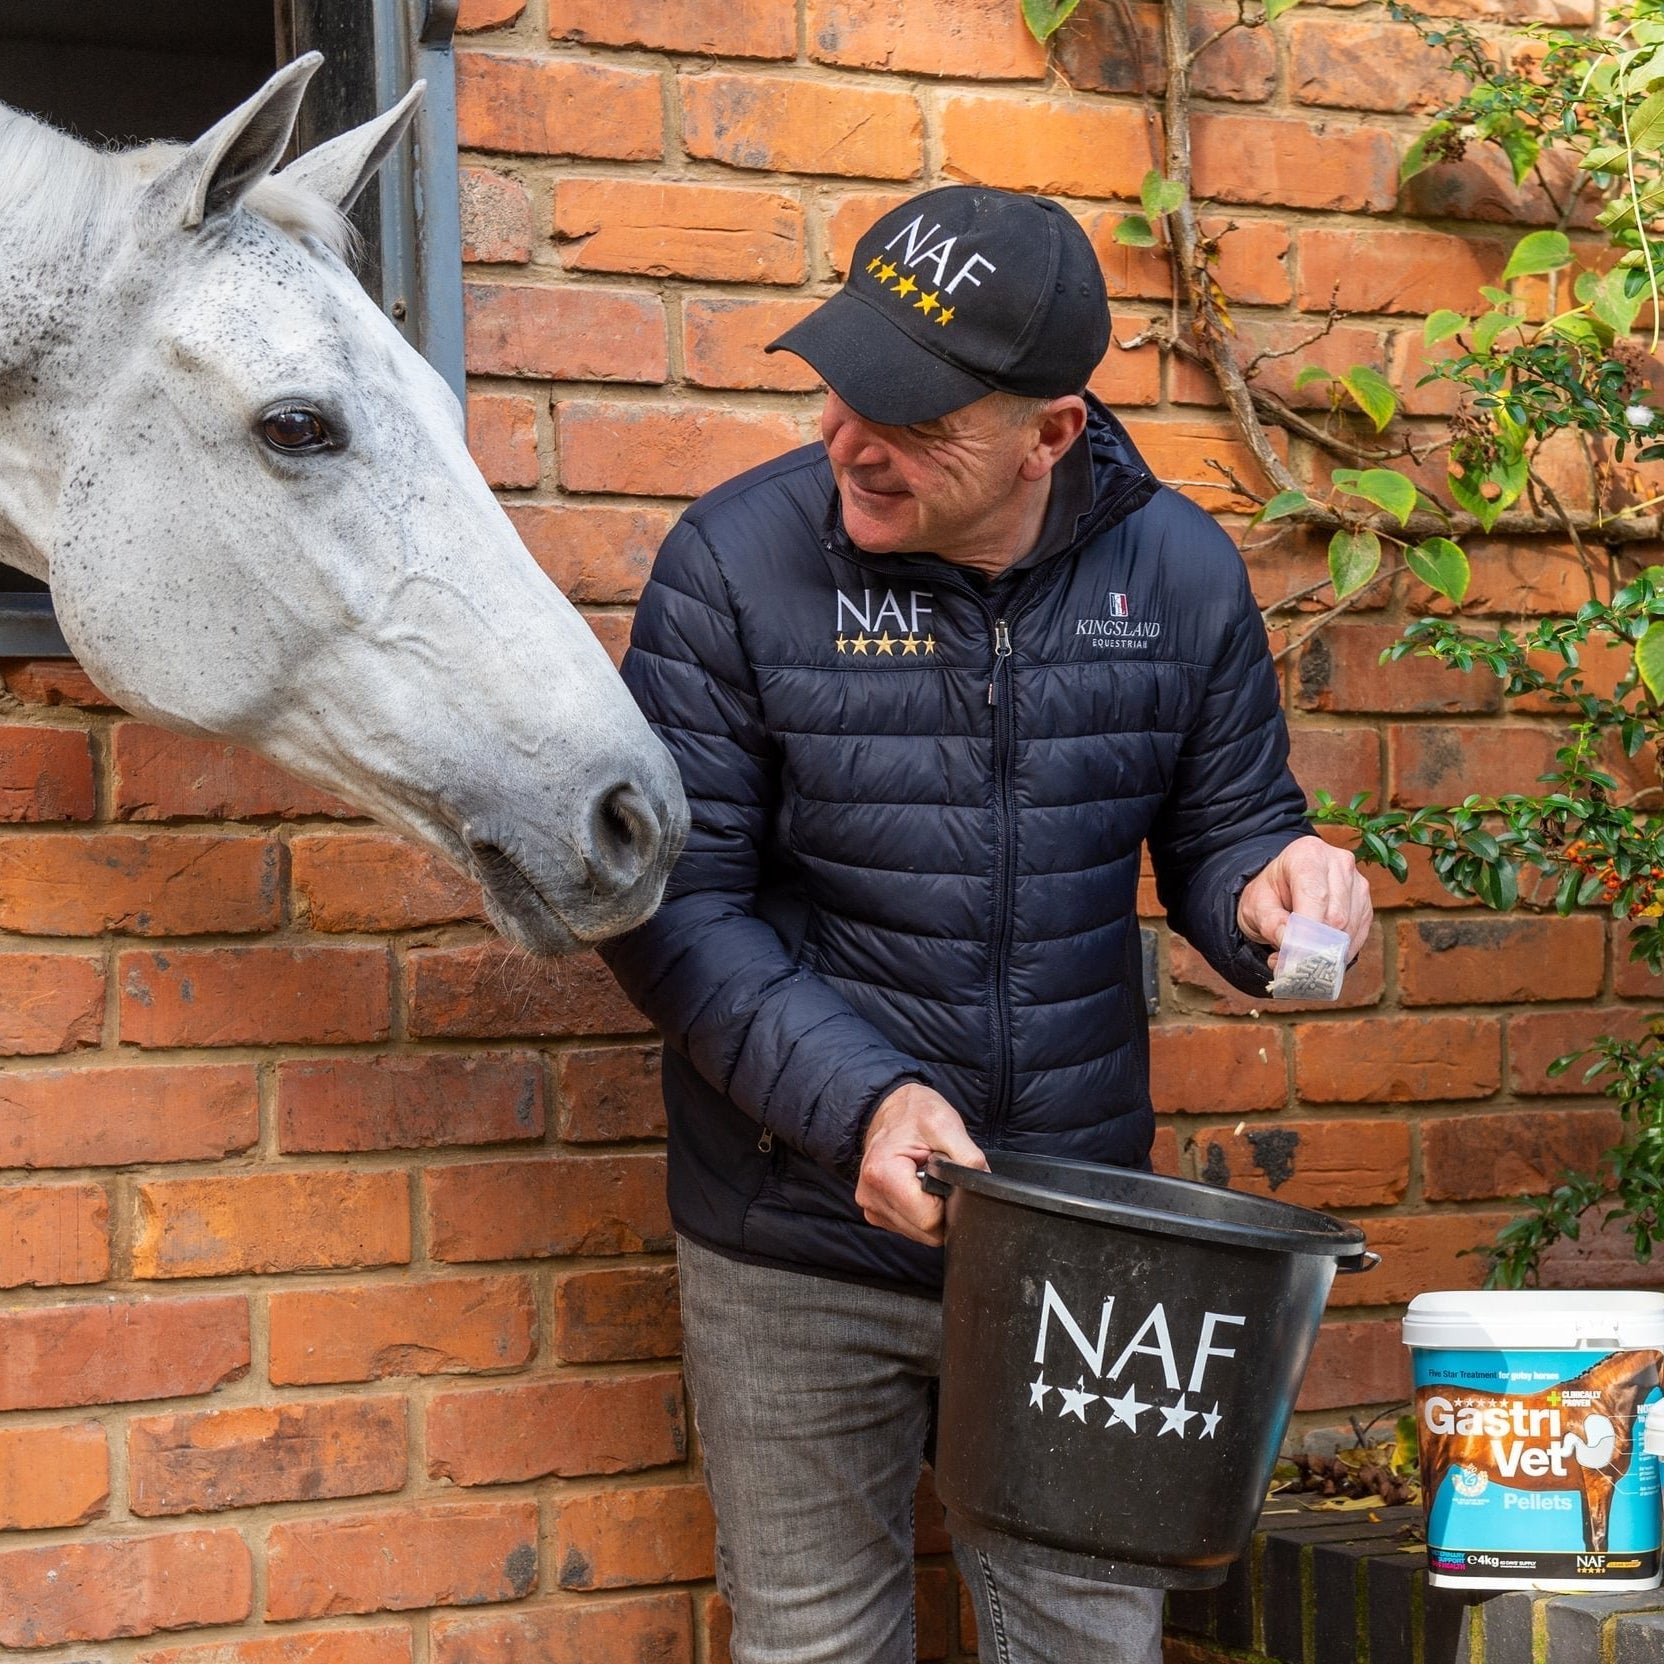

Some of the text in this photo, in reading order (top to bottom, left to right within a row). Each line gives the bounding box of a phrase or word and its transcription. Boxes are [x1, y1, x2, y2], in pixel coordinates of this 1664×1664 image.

[885, 214, 997, 294] NAF
[837, 589, 933, 632] NAF
[1076, 620, 1160, 638] KINGSLAND
[1092, 639, 1148, 649] EQUESTRIAN
[1034, 1280, 1246, 1393] NAF
[1428, 1369, 1441, 1377] Five
[1443, 1370, 1458, 1379] Star
[1460, 1371, 1497, 1380] Treatment
[1424, 1396, 1560, 1437] Gastri
[1489, 1439, 1568, 1478] Vet
[1503, 1493, 1572, 1510] Pellets
[1576, 1555, 1606, 1568] NAF
